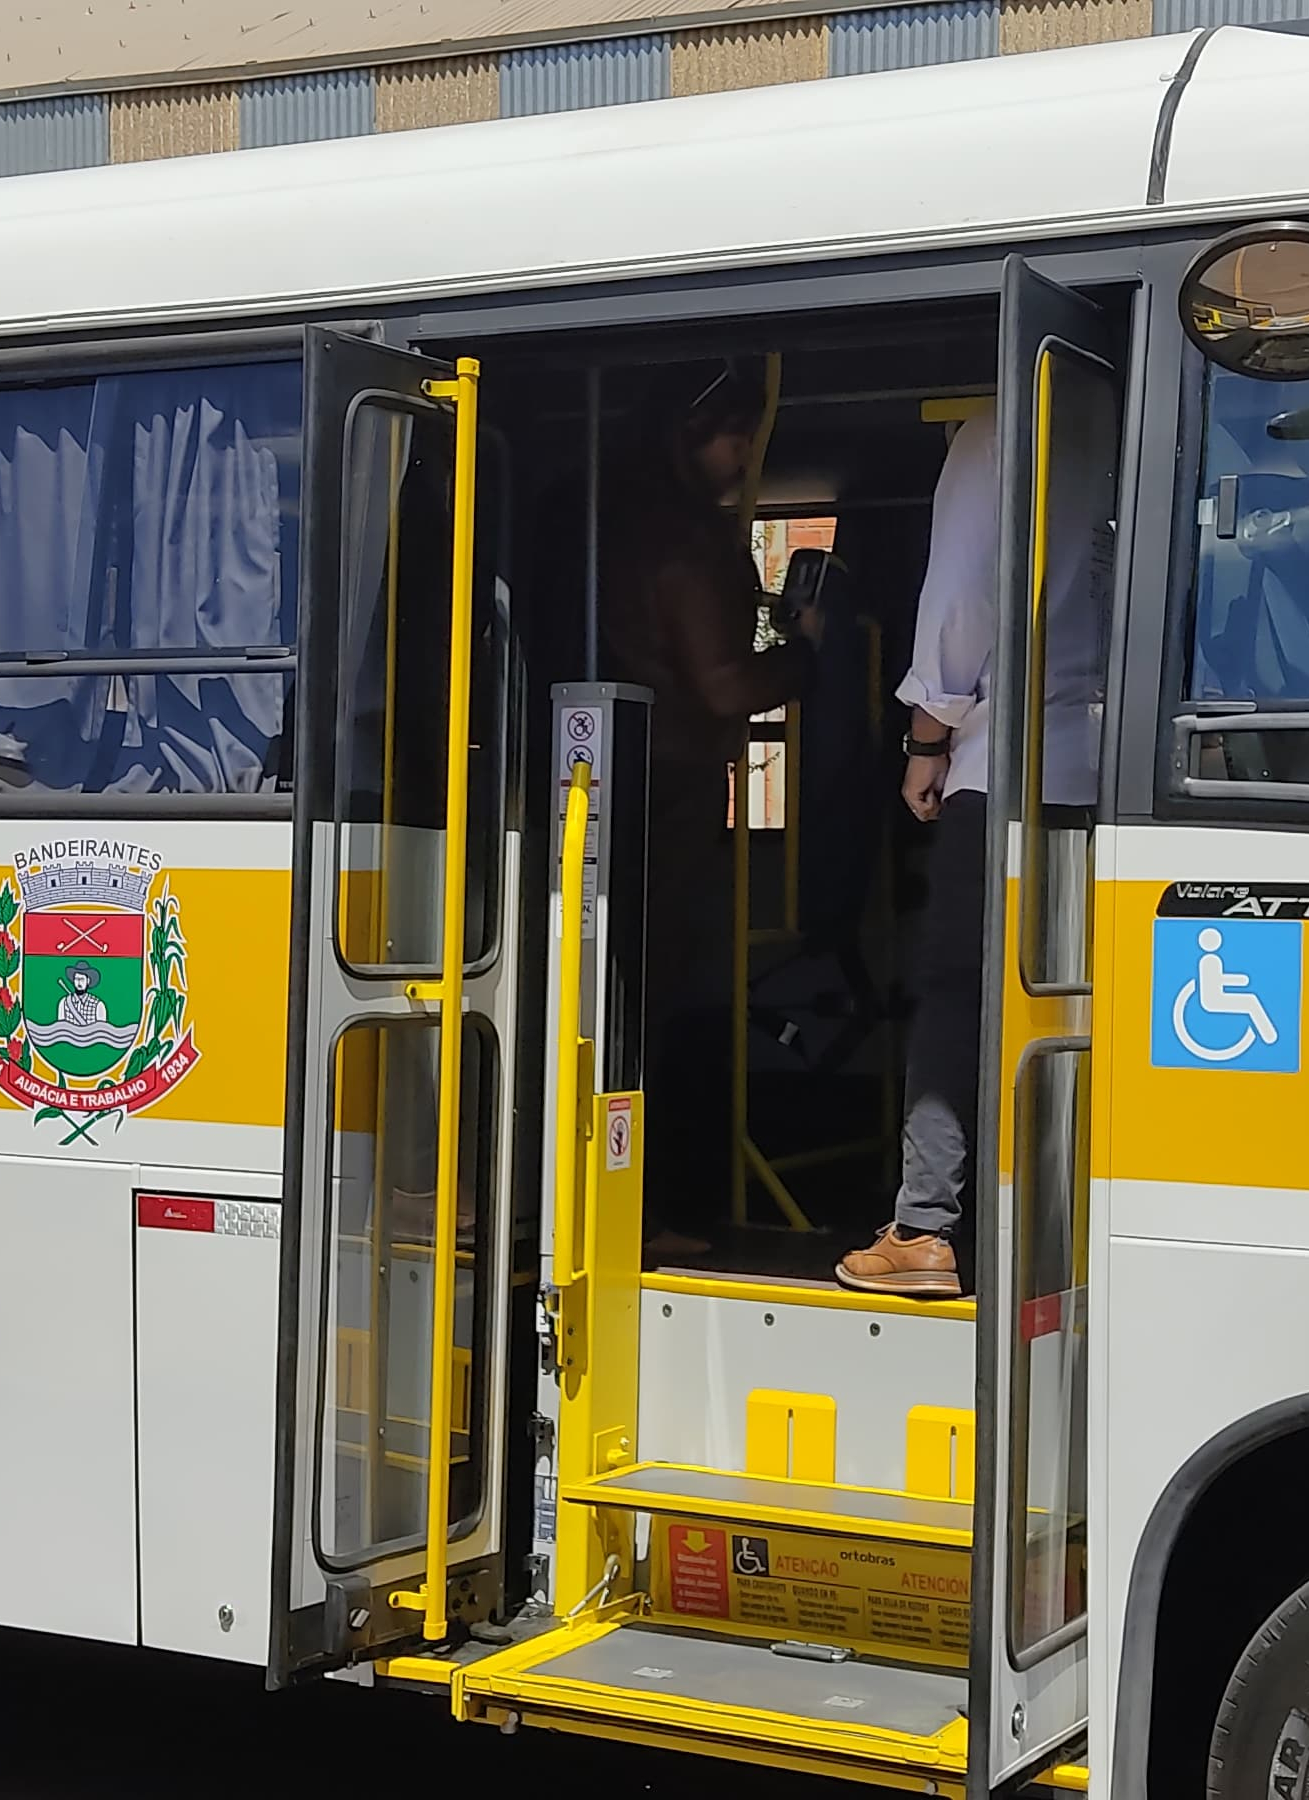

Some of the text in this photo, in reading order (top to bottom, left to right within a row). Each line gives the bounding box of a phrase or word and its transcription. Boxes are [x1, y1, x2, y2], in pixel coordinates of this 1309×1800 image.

[14, 839, 162, 871] BANDEIRANTES
[14, 1052, 189, 1107] AUDÁCIA E TRABALHO 1934
[840, 1550, 896, 1567] ortobras
